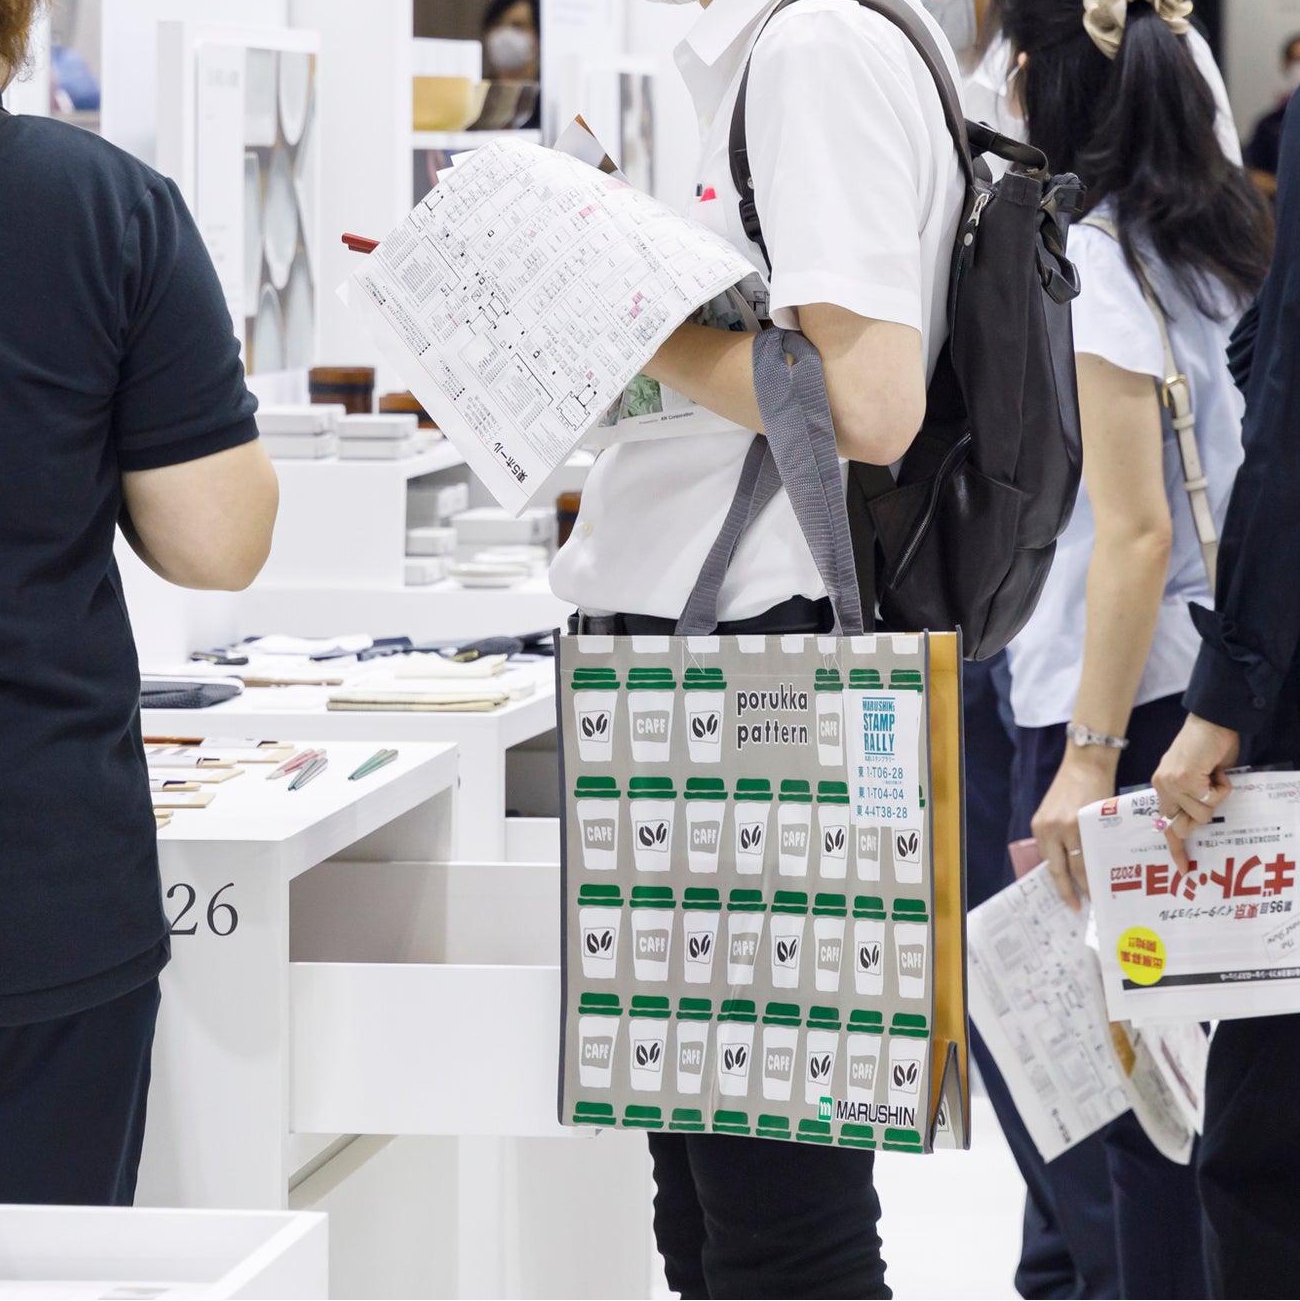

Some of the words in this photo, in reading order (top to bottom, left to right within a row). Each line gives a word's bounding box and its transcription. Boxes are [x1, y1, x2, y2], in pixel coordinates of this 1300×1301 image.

[493, 441, 529, 484] 東5ホール
[737, 684, 809, 716] porukka
[737, 720, 808, 749] pattern
[863, 713, 895, 732] STAMP
[864, 732, 895, 752] RALLY
[1110, 853, 1296, 902] ギフト・ショー
[167, 882, 239, 937] 26
[836, 1100, 915, 1126] MARUSHIN
